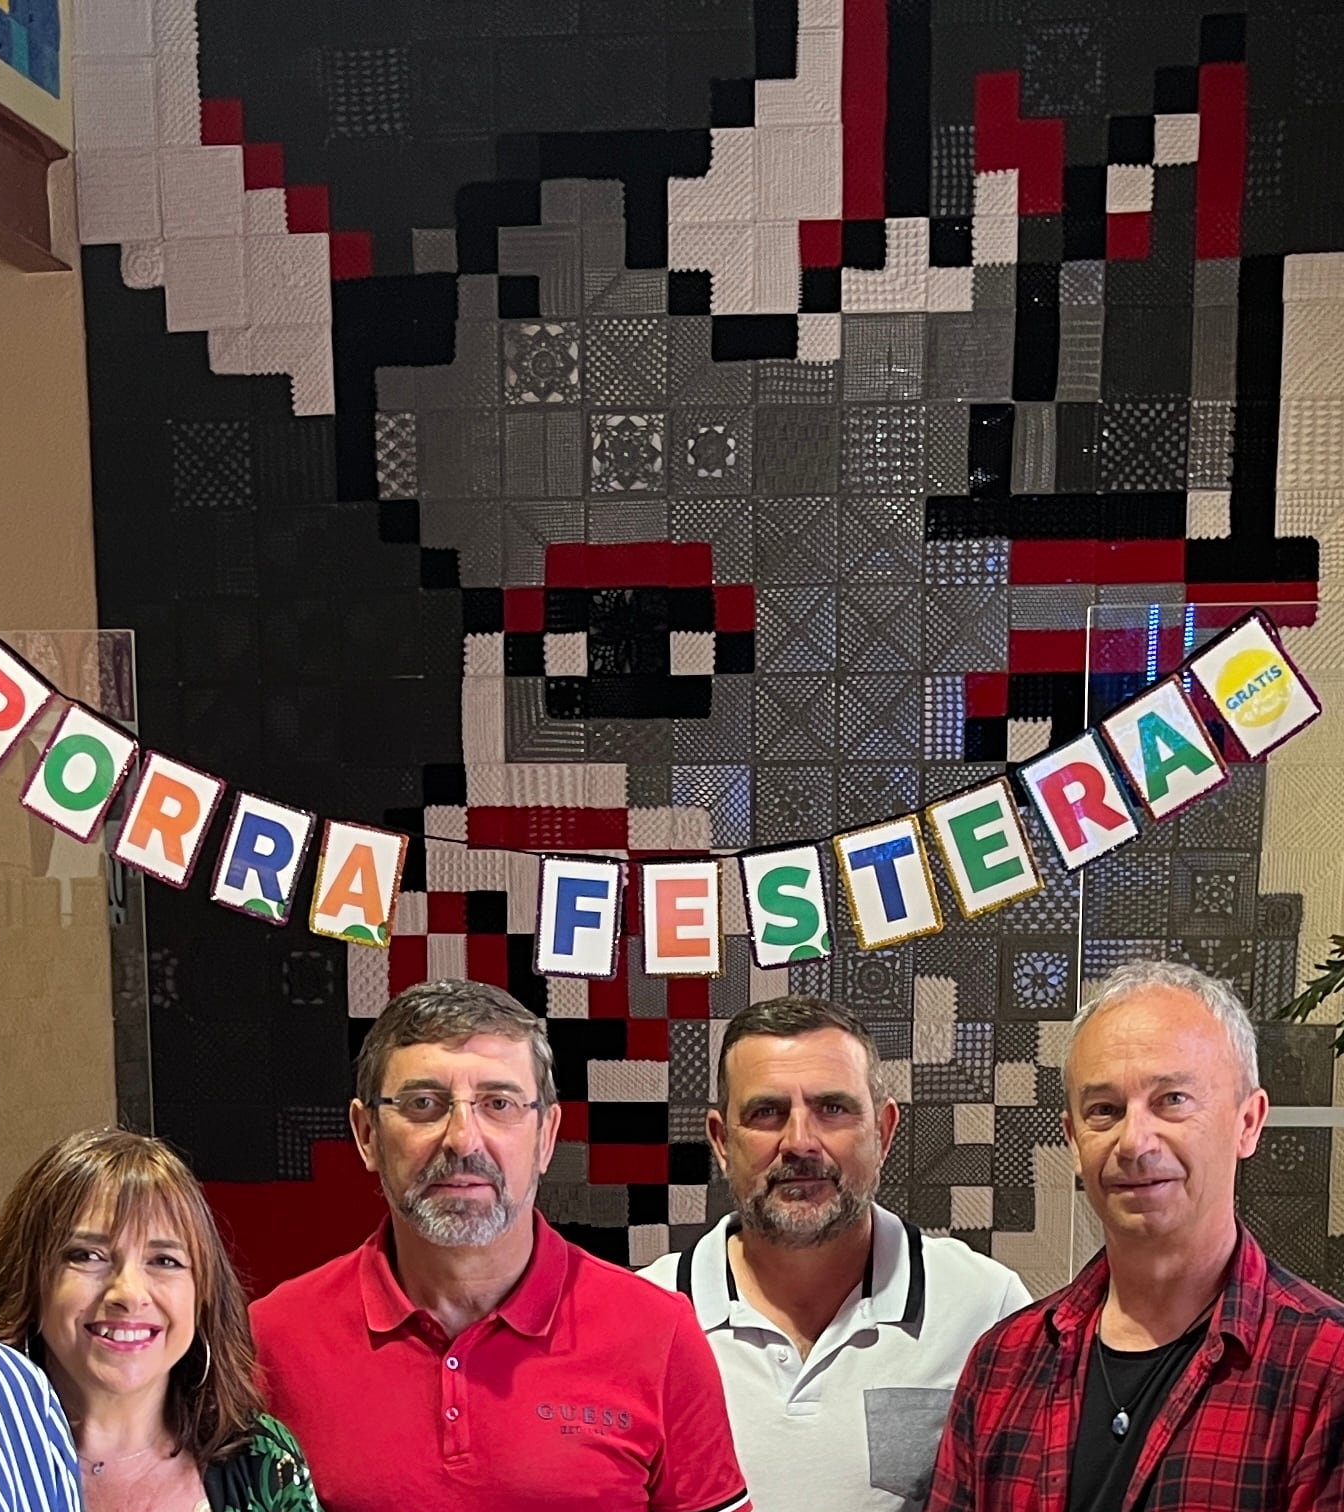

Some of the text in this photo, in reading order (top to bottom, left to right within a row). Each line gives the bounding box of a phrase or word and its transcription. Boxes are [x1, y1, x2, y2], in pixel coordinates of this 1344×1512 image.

[1225, 665, 1283, 710] GRATIS
[554, 711, 1215, 957] FESTERA
[536, 1403, 632, 1430] GUESS
